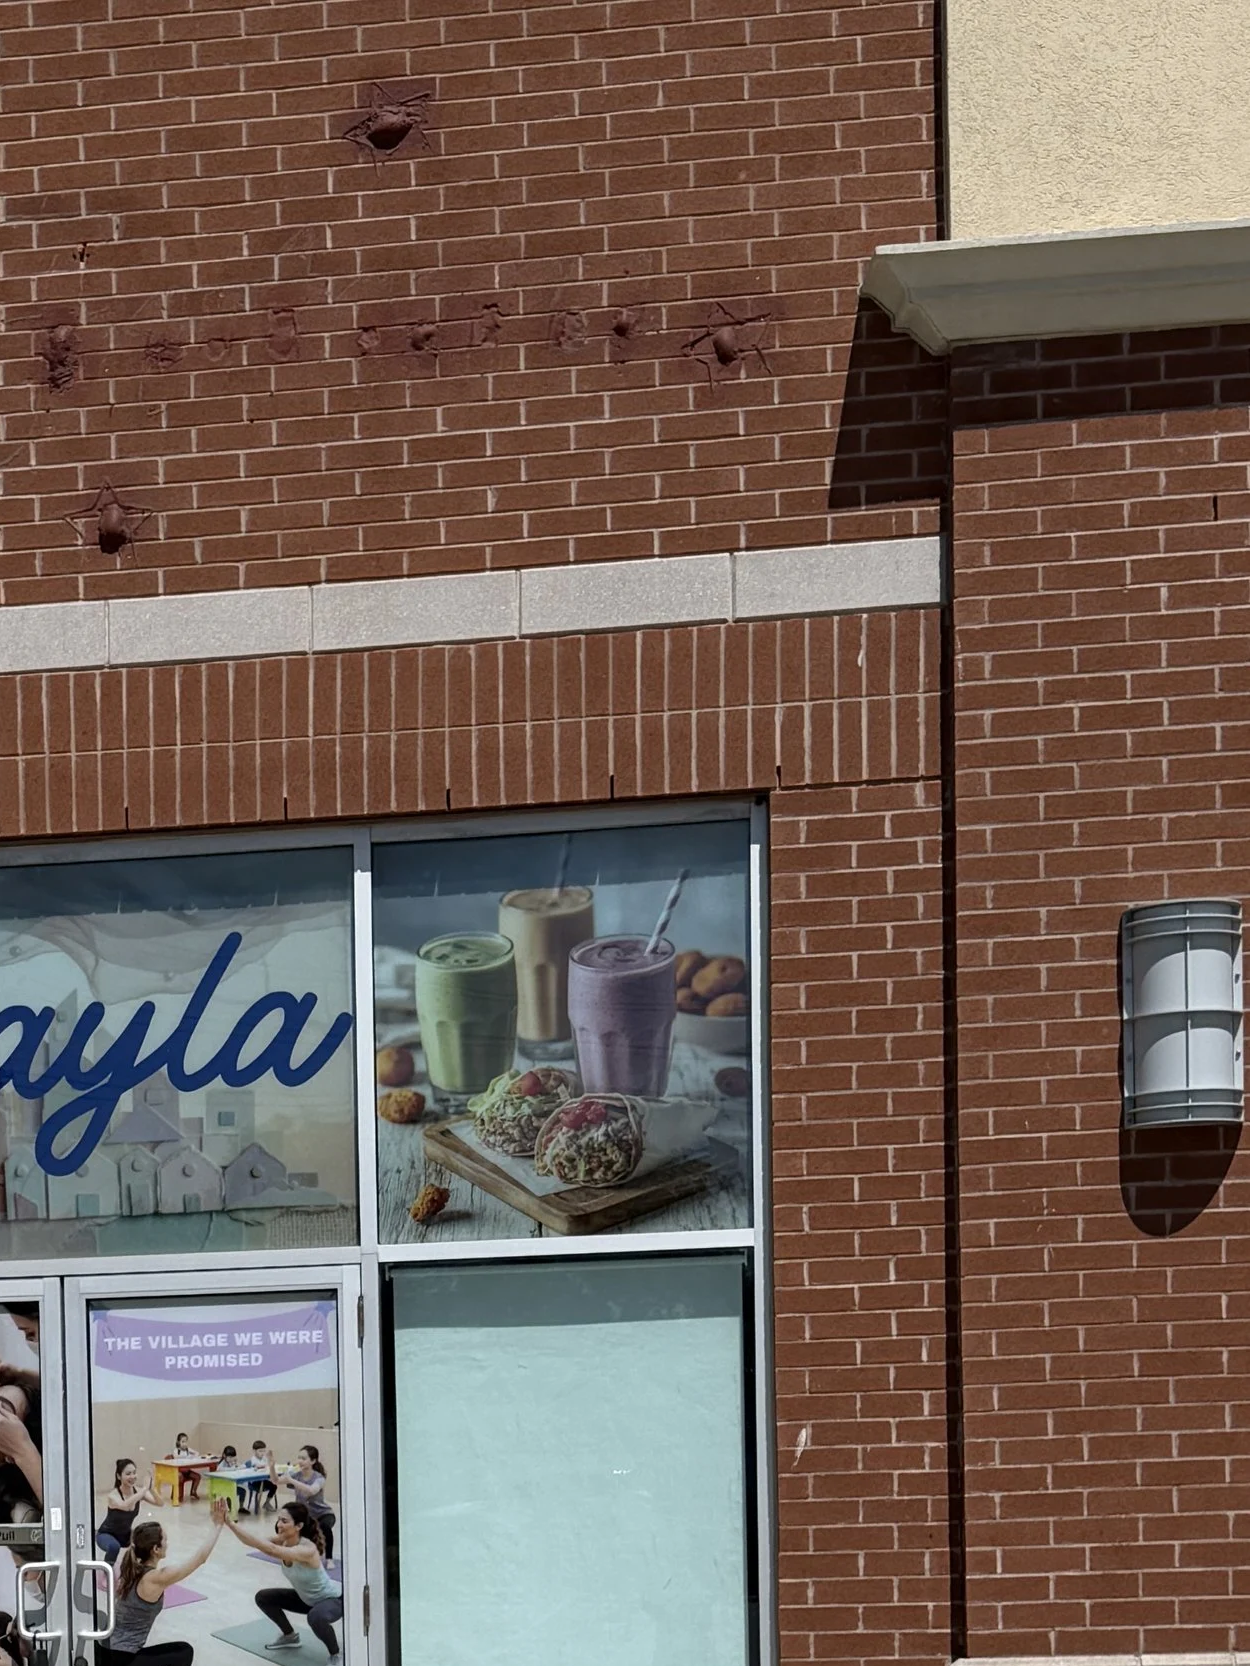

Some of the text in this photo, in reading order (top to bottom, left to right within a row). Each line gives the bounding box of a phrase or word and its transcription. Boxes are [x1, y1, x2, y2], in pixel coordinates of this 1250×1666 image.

[104, 1329, 323, 1351] THE VILLAGE WE WERE
[165, 1352, 263, 1369] PROMISED
